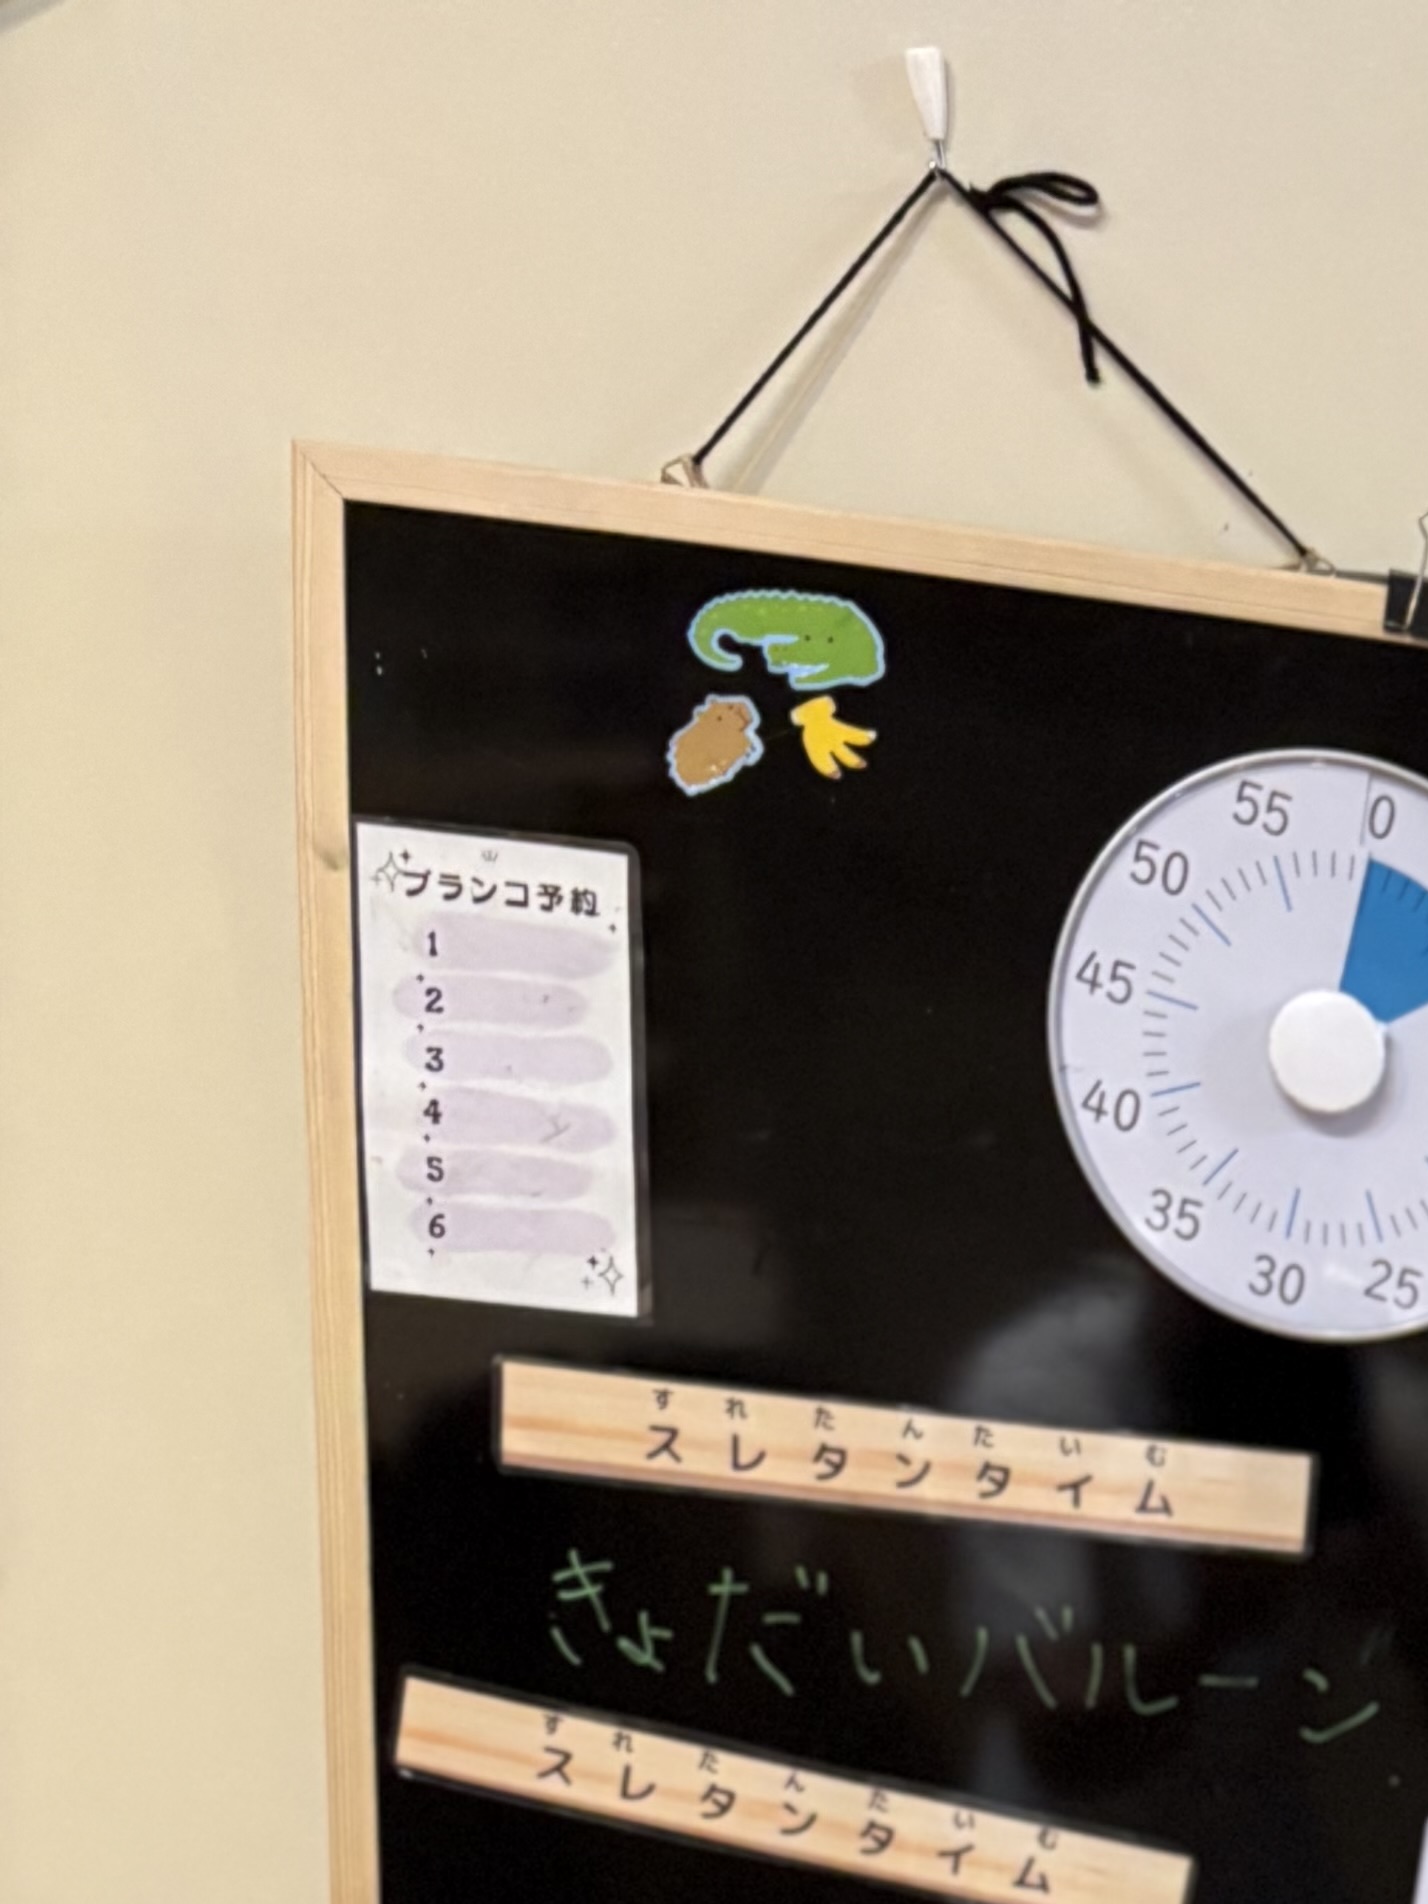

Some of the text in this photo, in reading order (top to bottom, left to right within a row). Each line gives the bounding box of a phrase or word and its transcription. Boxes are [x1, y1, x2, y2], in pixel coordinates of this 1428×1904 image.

[1232, 779, 1292, 836] 55
[1368, 795, 1396, 839] 0
[1129, 838, 1190, 896] 50
[401, 869, 600, 918] ブランコ予約
[426, 931, 439, 957] 1
[424, 988, 444, 1013] 2
[1074, 951, 1136, 1005] 45
[424, 1047, 444, 1073] 3
[422, 1099, 442, 1125] 4
[1081, 1079, 1141, 1132] 40
[425, 1157, 445, 1183] 5
[428, 1213, 446, 1239] 6
[1144, 1188, 1203, 1241] 35
[1248, 1254, 1305, 1306] 30
[1363, 1258, 1423, 1310] 25
[652, 1387, 1168, 1467] すれたんたいむ
[645, 1424, 1173, 1518] スレタンタイム
[551, 1549, 1380, 1742] きょだいバルーン
[541, 1713, 1057, 1851] すれたんたいむ
[536, 1745, 1050, 1894] スレタンタイム
